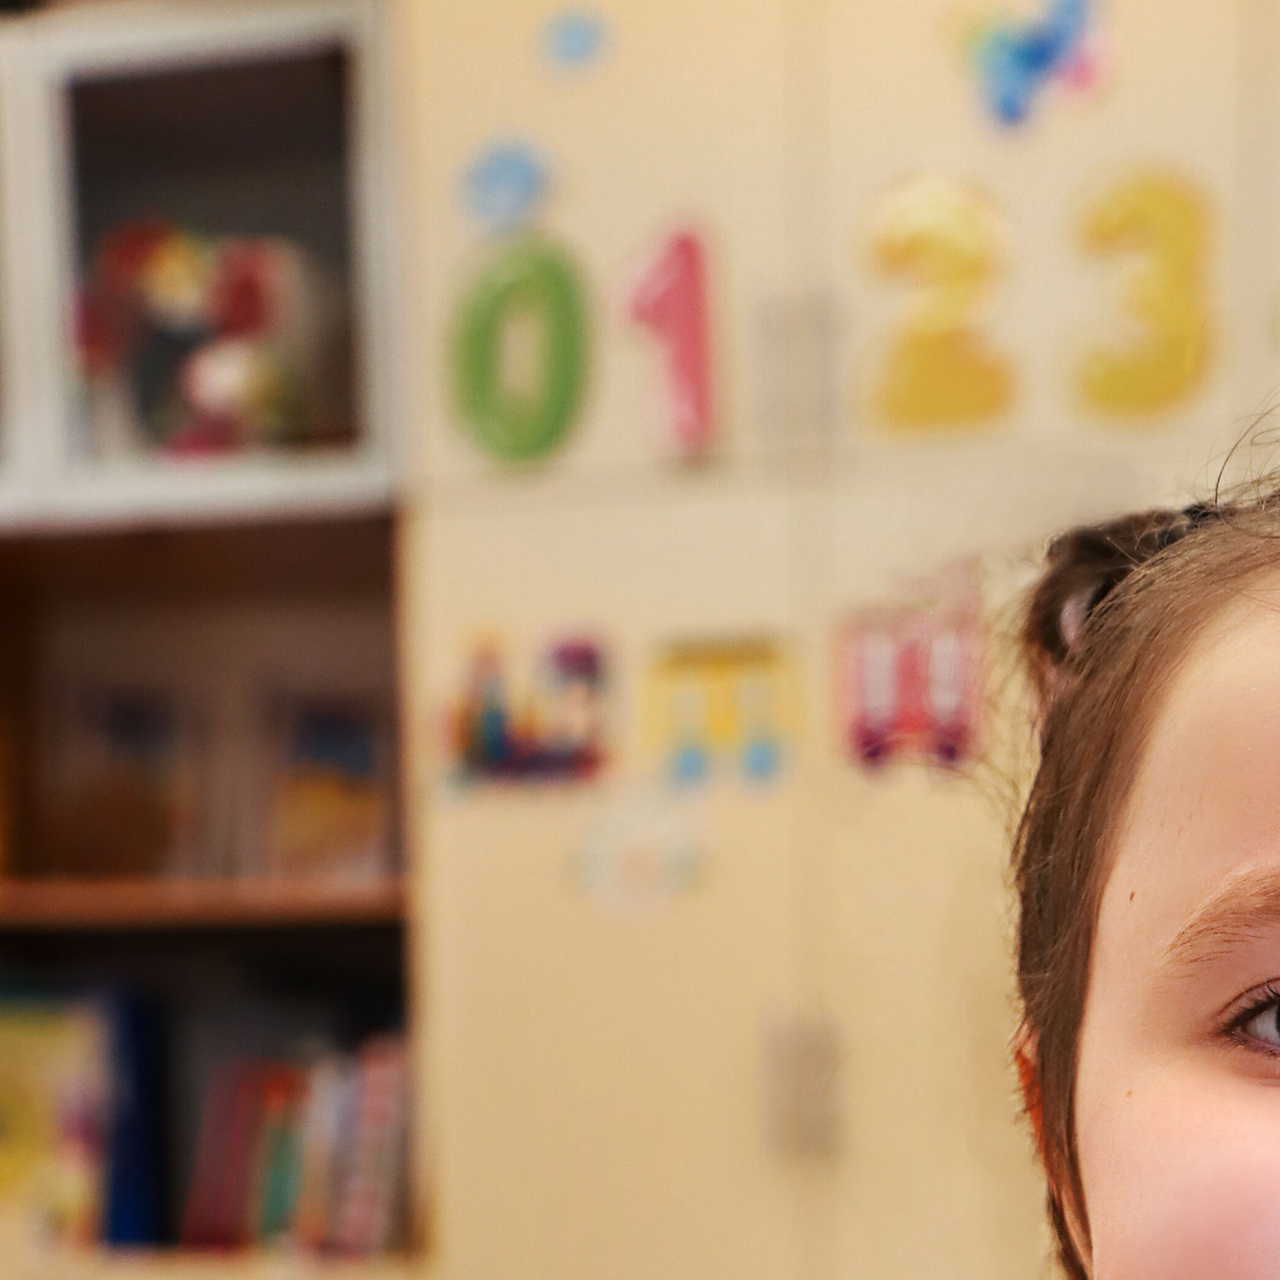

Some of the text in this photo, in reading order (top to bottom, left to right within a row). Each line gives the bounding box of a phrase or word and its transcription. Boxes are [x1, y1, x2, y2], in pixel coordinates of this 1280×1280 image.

[448, 234, 590, 468] 0
[626, 226, 714, 462] 1
[866, 175, 1016, 430] 2
[1074, 160, 1214, 420] 3
